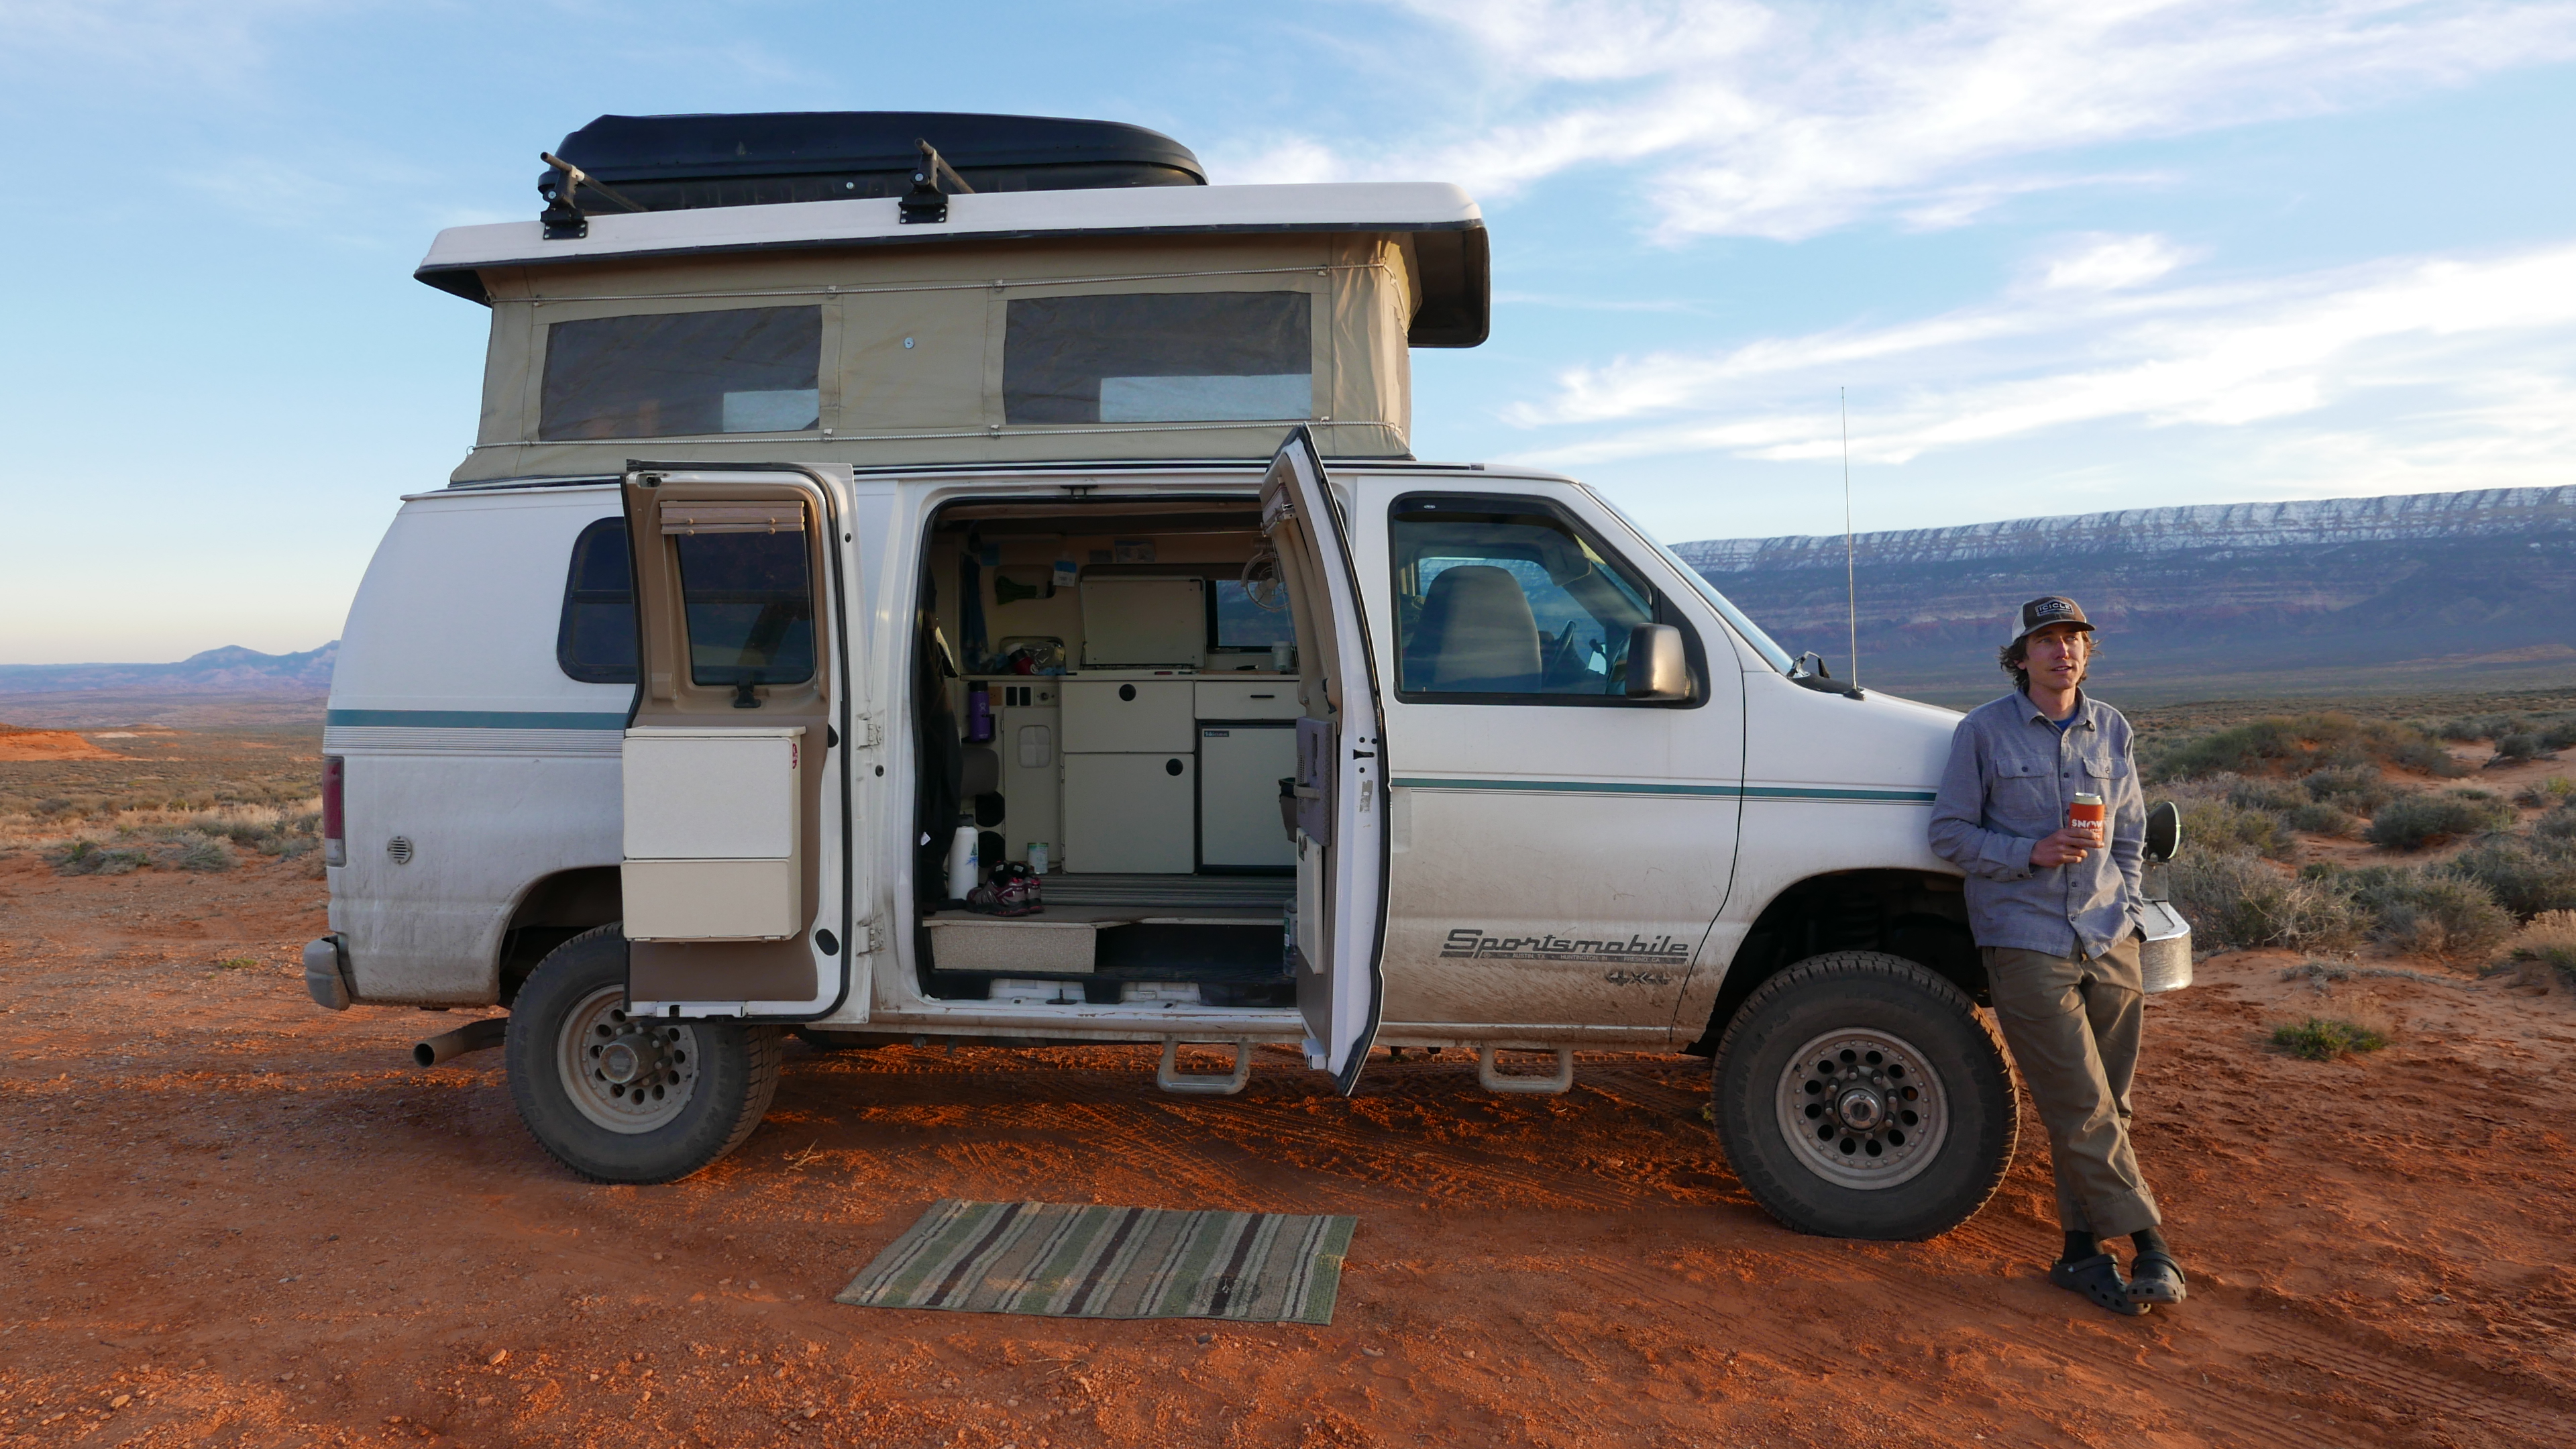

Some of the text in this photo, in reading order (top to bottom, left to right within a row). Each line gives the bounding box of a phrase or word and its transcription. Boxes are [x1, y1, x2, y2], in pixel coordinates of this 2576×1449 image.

[2039, 603, 2070, 611] ICICLE
[2072, 818, 2102, 828] SNOW
[1443, 928, 1689, 959] Sportsmobile
